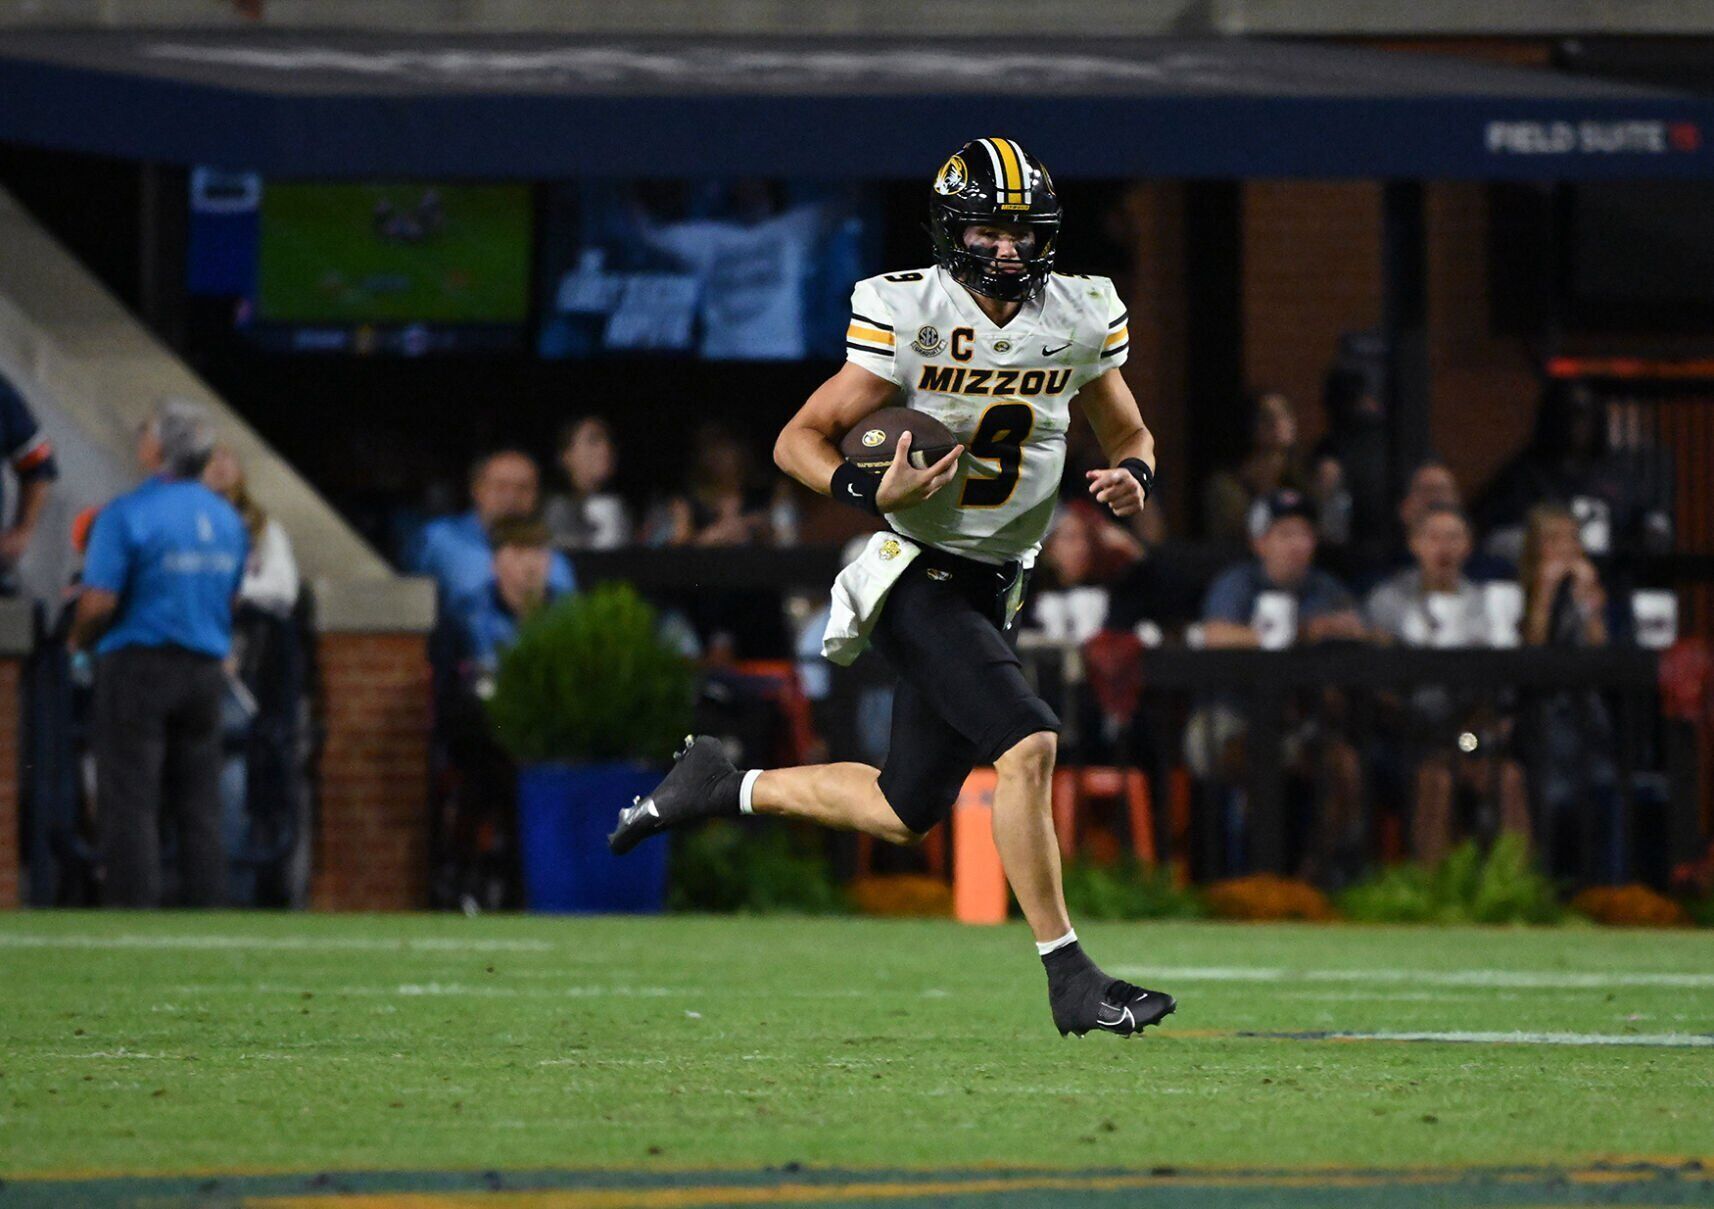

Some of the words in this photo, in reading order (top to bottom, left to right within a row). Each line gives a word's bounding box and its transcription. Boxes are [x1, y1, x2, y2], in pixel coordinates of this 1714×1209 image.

[951, 327, 975, 363] C
[918, 365, 1072, 397] MIZZOU
[960, 401, 1035, 508] 9
